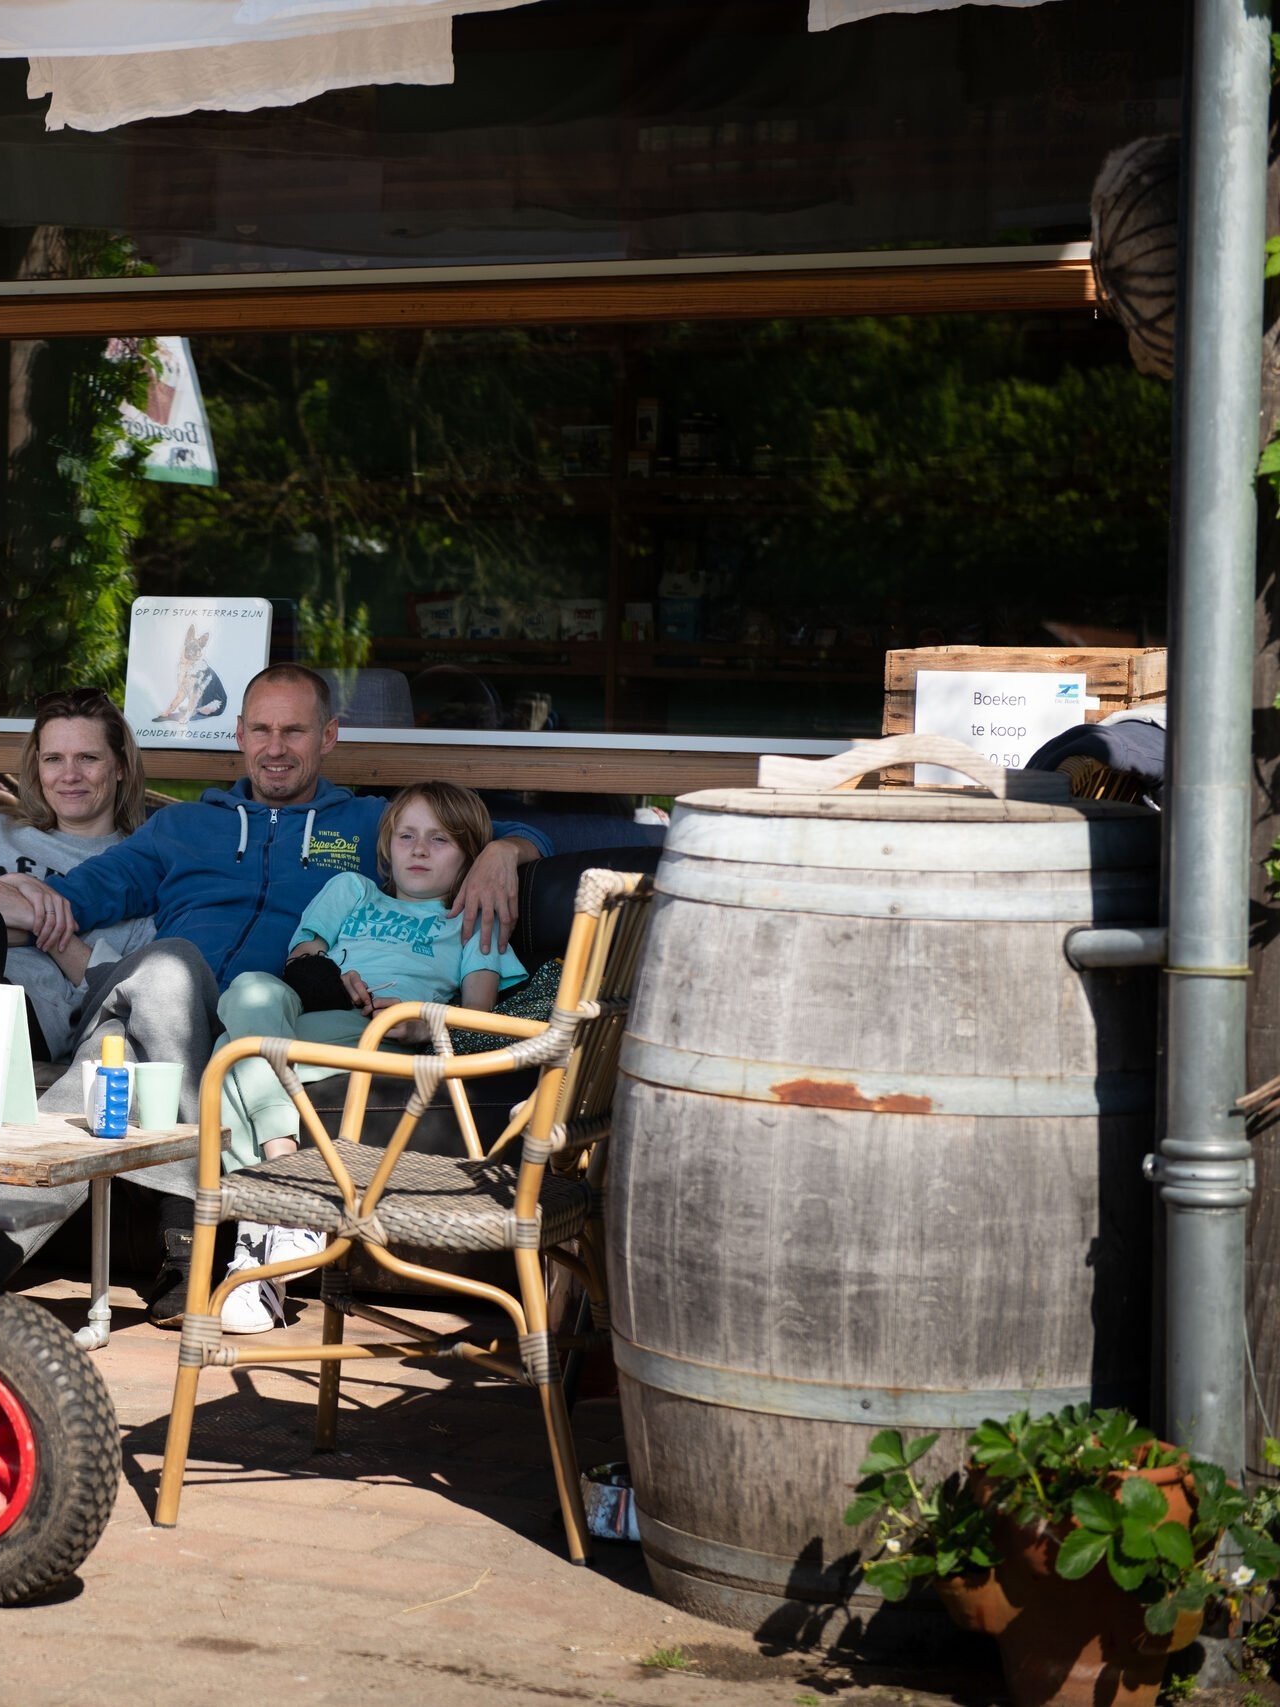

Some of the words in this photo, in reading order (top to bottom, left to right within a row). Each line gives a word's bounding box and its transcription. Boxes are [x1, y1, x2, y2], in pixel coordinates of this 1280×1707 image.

[135, 608, 150, 616] OP
[152, 608, 169, 616] DIT
[172, 608, 198, 617] STUK
[201, 609, 239, 617] TERRAS
[241, 610, 264, 618] ZIJN
[973, 691, 1027, 706] Boeken
[136, 728, 177, 738] HONDEN
[180, 729, 238, 740] TOEGESTAA
[971, 724, 985, 737] te
[990, 722, 1027, 740] koop
